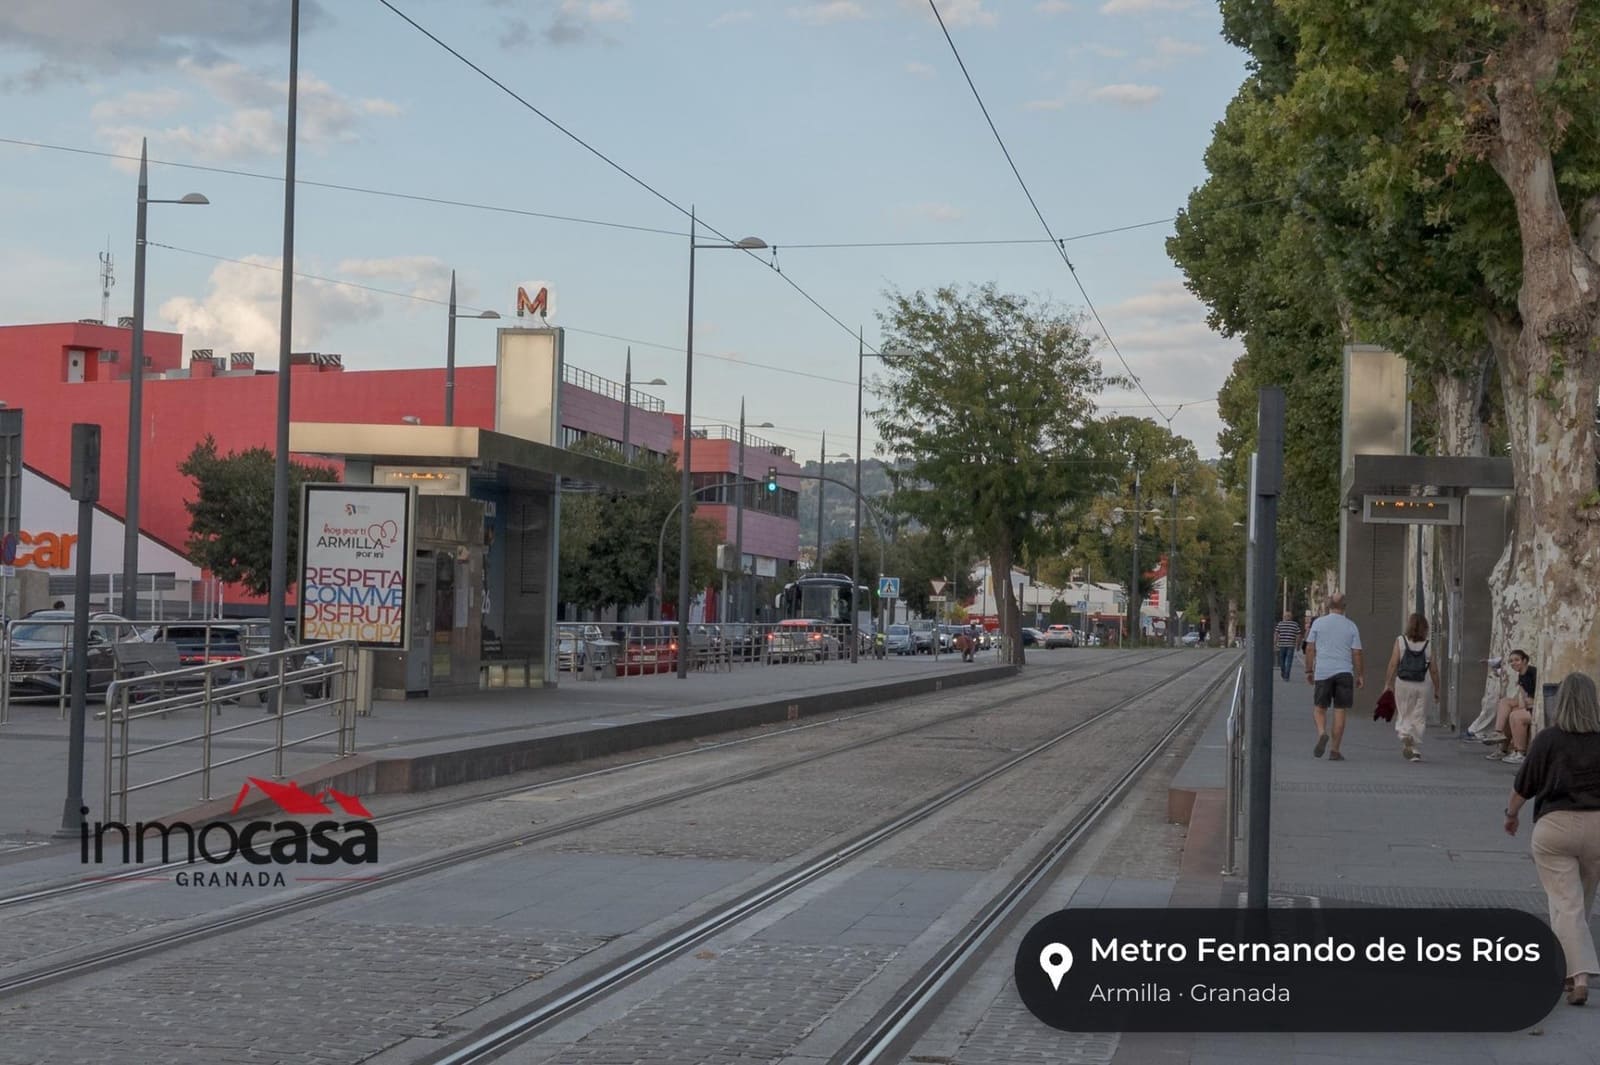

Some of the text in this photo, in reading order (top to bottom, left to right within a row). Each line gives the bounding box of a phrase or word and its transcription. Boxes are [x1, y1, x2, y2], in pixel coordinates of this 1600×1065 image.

[517, 286, 548, 317] M
[316, 535, 386, 550] ARMILLA
[355, 551, 373, 560] por
[305, 567, 404, 589] RESPETA
[304, 584, 403, 608] CONVIVE
